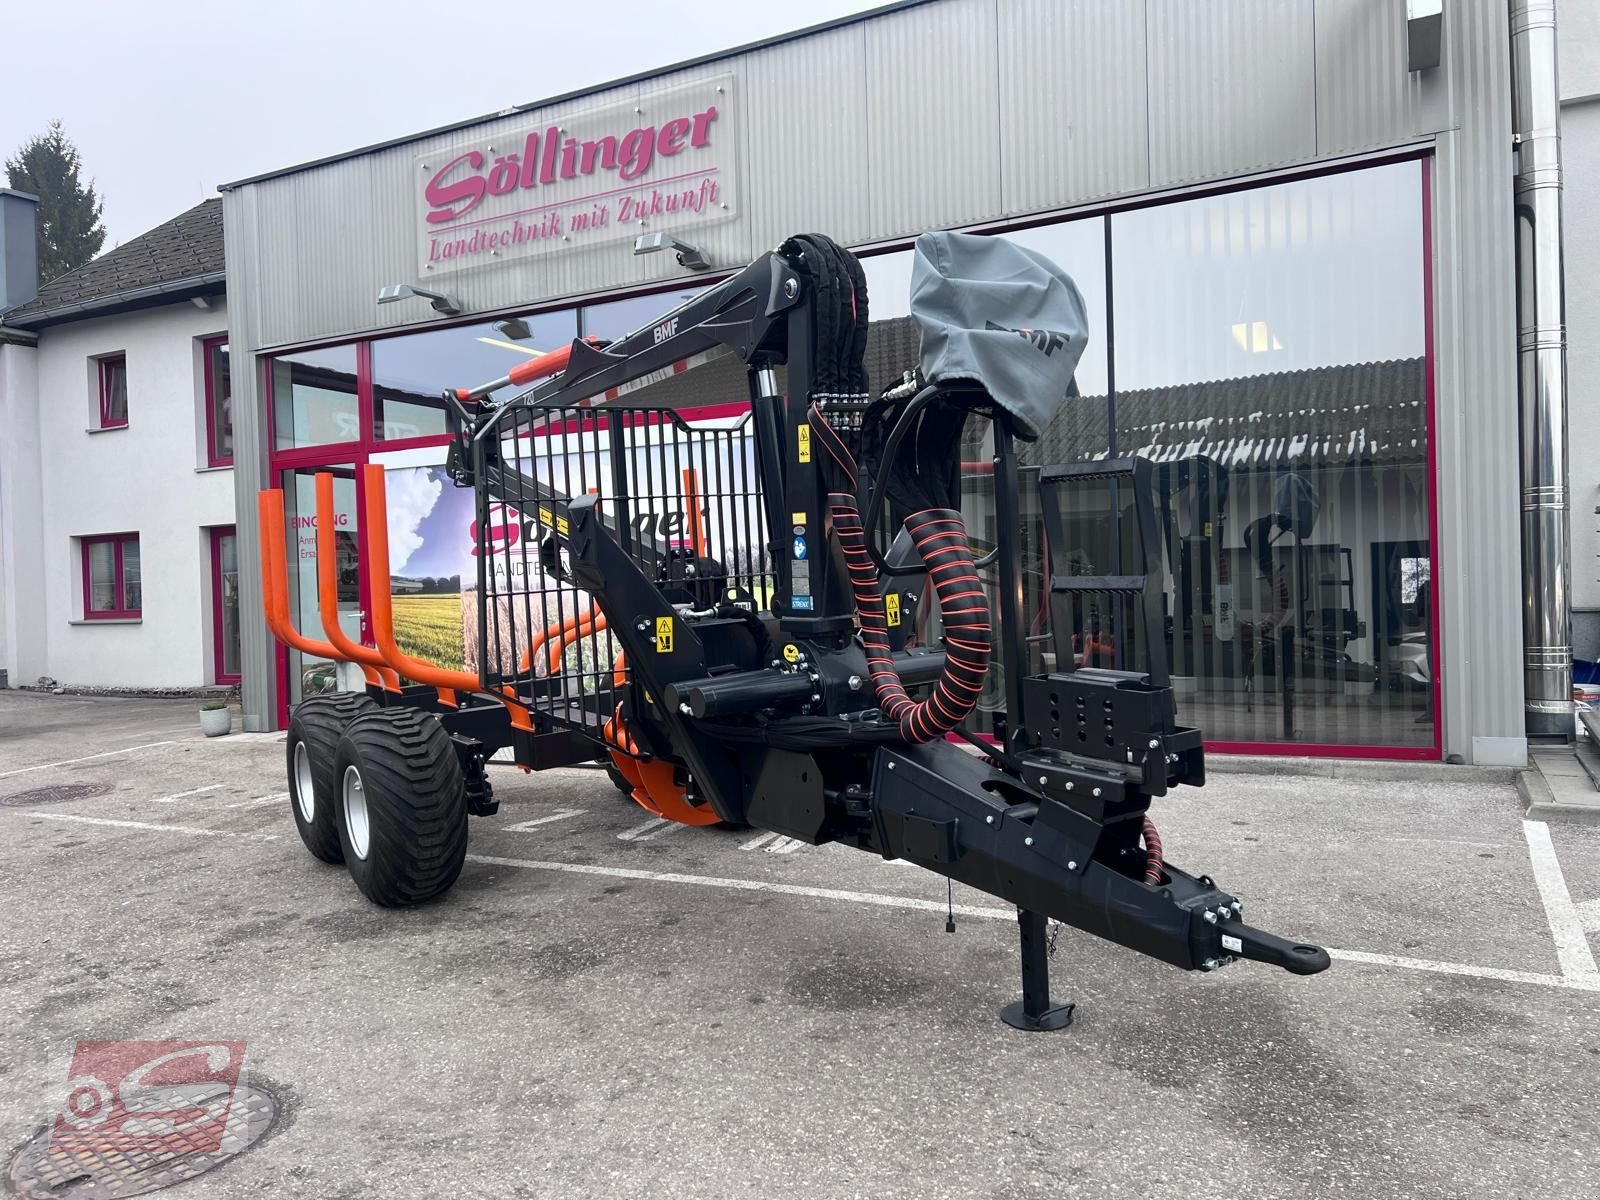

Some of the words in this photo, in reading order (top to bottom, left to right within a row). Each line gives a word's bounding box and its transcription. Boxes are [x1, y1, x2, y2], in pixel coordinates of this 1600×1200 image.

[425, 106, 717, 223] Söllinger
[429, 212, 561, 262] Landtechnik
[571, 204, 607, 231] mit
[617, 178, 718, 222] Zukunft
[653, 316, 679, 345] BMF
